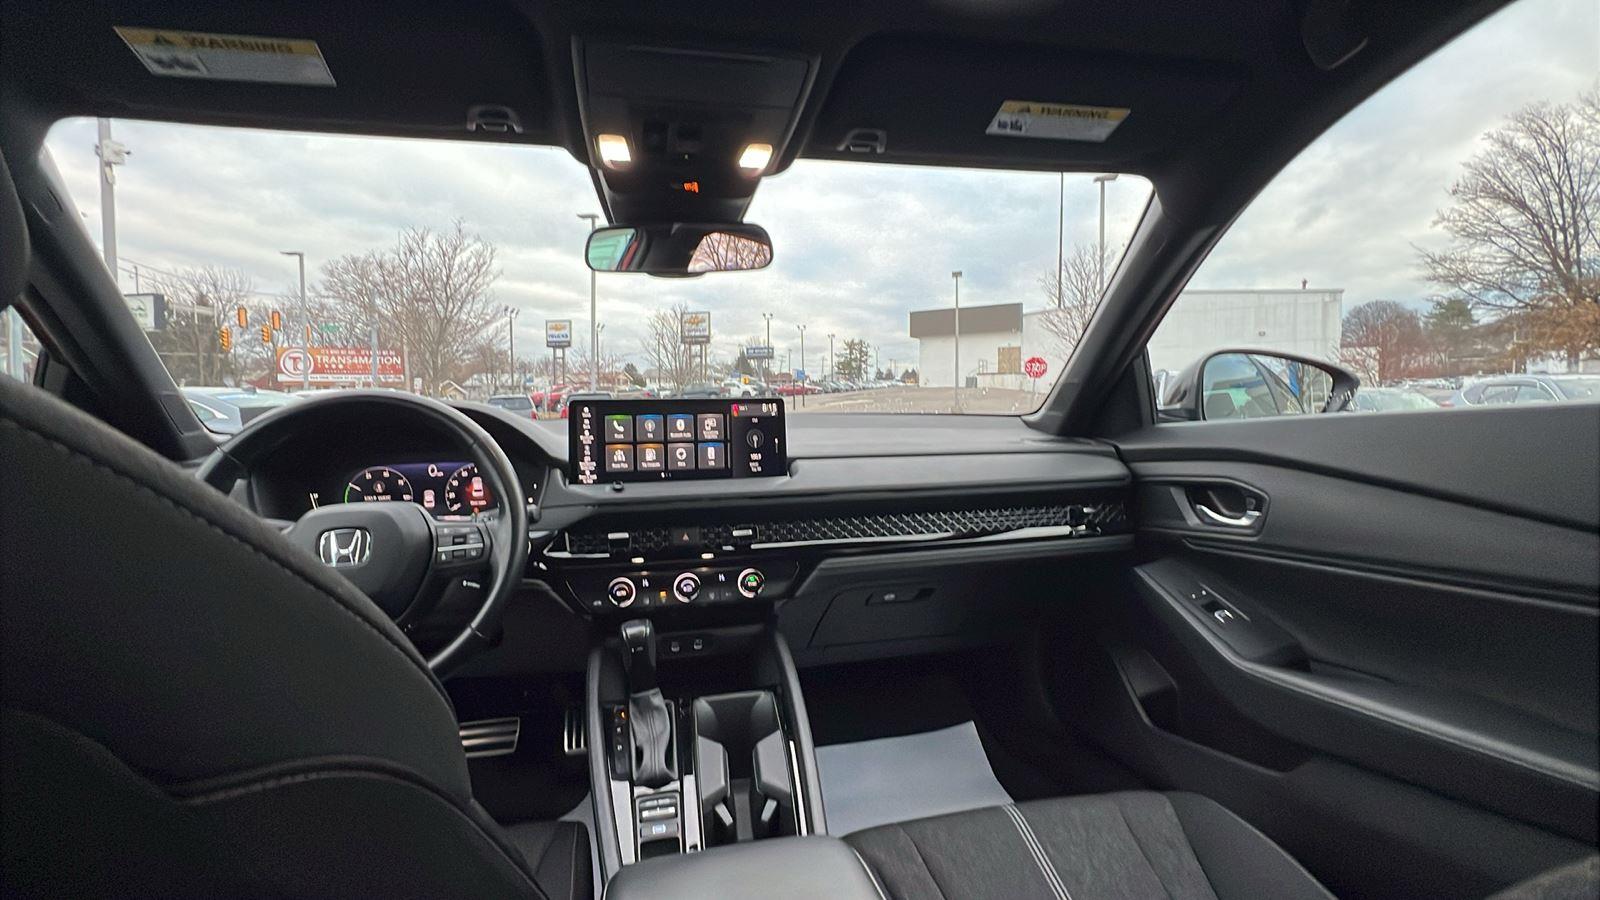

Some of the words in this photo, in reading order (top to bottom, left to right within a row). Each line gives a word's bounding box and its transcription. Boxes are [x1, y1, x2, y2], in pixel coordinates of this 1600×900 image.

[183, 36, 294, 54] WARNING
[1040, 106, 1109, 119] WARNING
[1025, 361, 1047, 371] STOP
